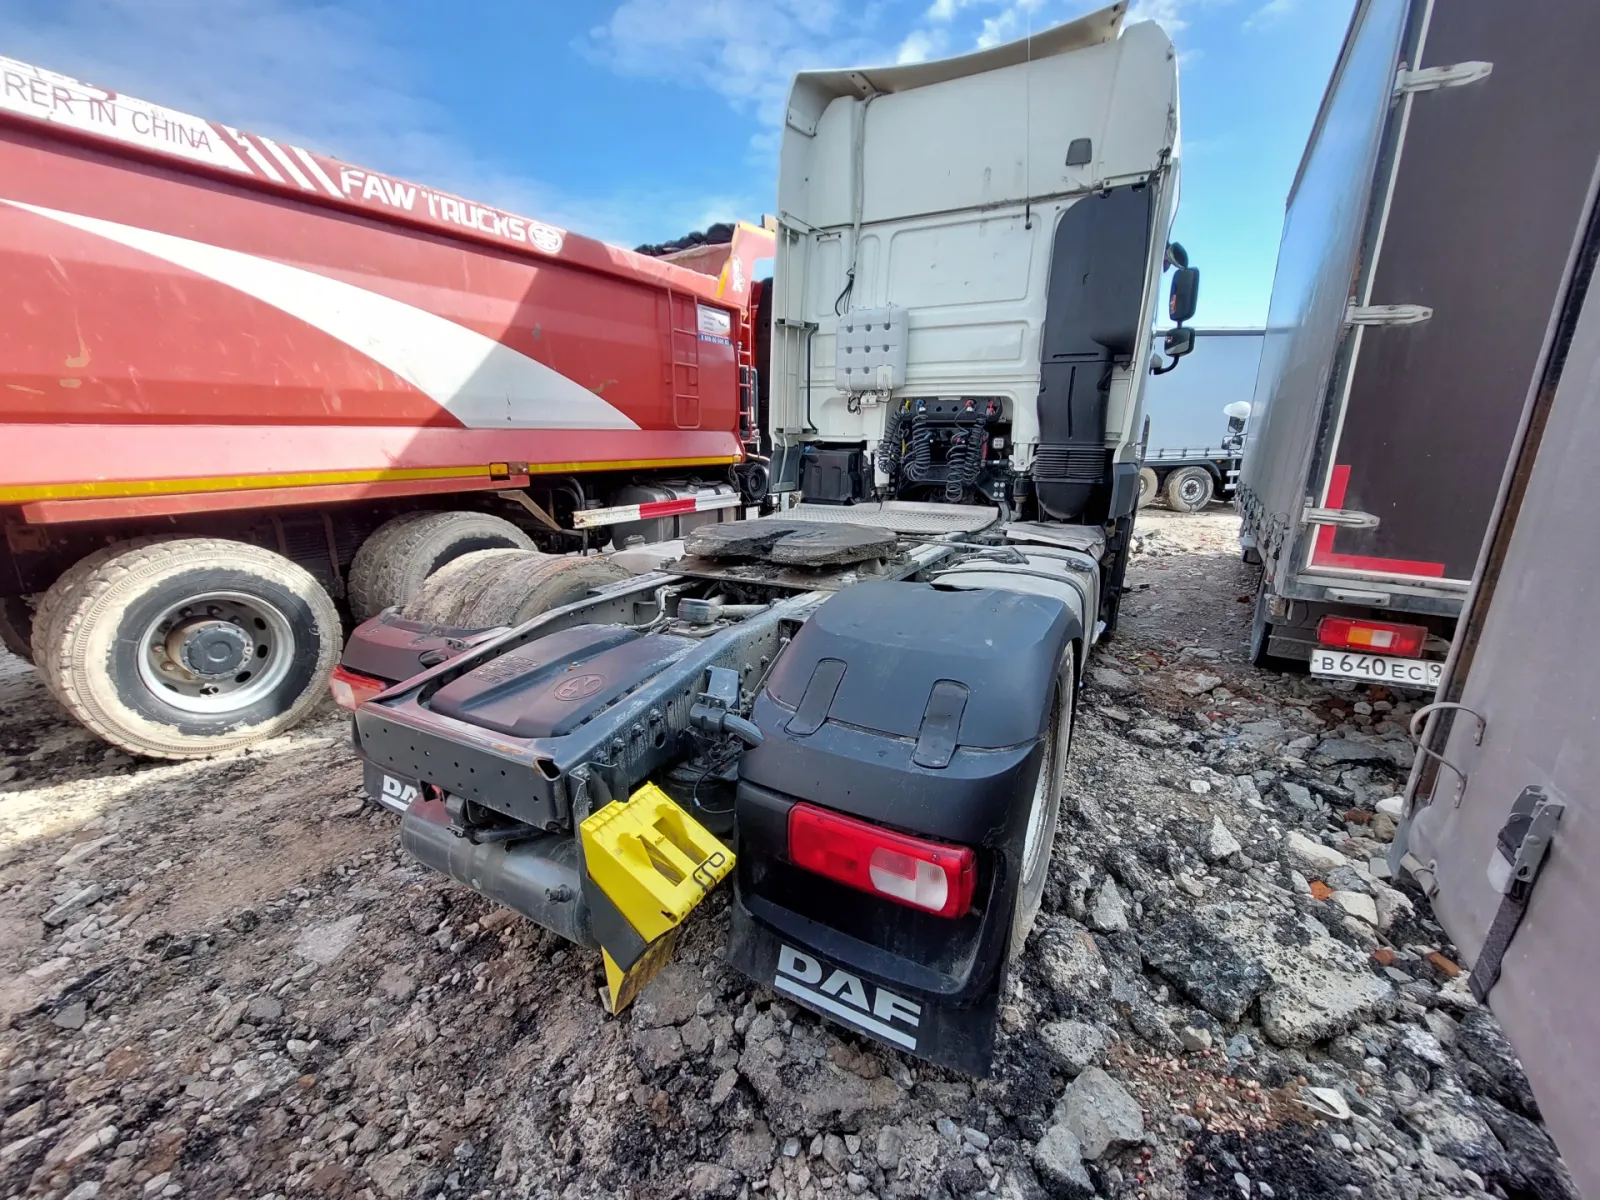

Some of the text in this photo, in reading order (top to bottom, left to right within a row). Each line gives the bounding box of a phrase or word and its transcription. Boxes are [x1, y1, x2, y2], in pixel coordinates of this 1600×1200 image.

[4, 71, 213, 153] RER IN CHINA
[340, 167, 526, 242] FAW TRUCKS
[382, 774, 418, 803] DA
[777, 943, 922, 1027] DAF
